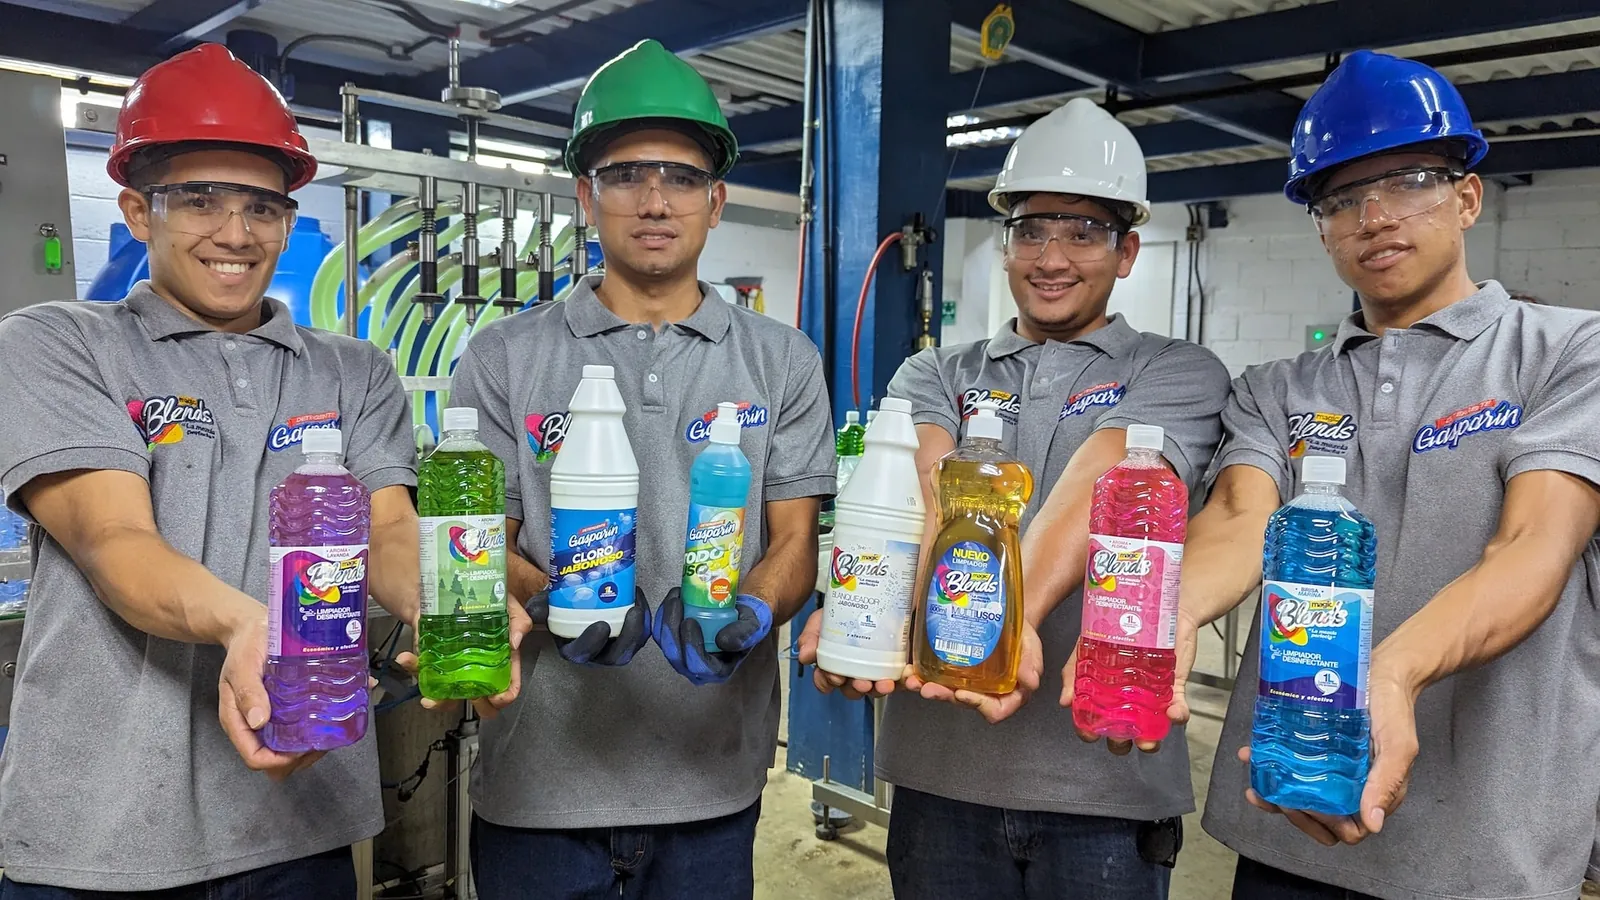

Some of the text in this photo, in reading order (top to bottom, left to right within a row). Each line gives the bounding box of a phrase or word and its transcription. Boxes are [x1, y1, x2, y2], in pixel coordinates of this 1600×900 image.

[962, 389, 1020, 416] Blnds
[143, 397, 212, 439] Blends
[690, 408, 765, 440] Gaarín
[1416, 404, 1519, 450] Gasparín
[1289, 413, 1355, 448] Blends
[568, 524, 619, 548] Gasparín
[689, 521, 736, 543] Gasparín
[559, 550, 624, 576] JABONOSO
[572, 545, 613, 564] CLORO
[952, 547, 990, 562] NUEVO
[952, 558, 988, 569] LIMPIADOR
[838, 553, 889, 577] Blends
[946, 570, 998, 593] Blends
[831, 590, 881, 606] BLANQUEADOR
[837, 600, 869, 610] JABONOSO
[1311, 601, 1332, 609] magic
[316, 606, 351, 615] LIMPIADOR
[1126, 615, 1137, 624] 1L
[1282, 649, 1321, 660] LIMPIADOR
[1282, 656, 1339, 669] DESINFECTANTE
[1323, 673, 1334, 683] 1L
